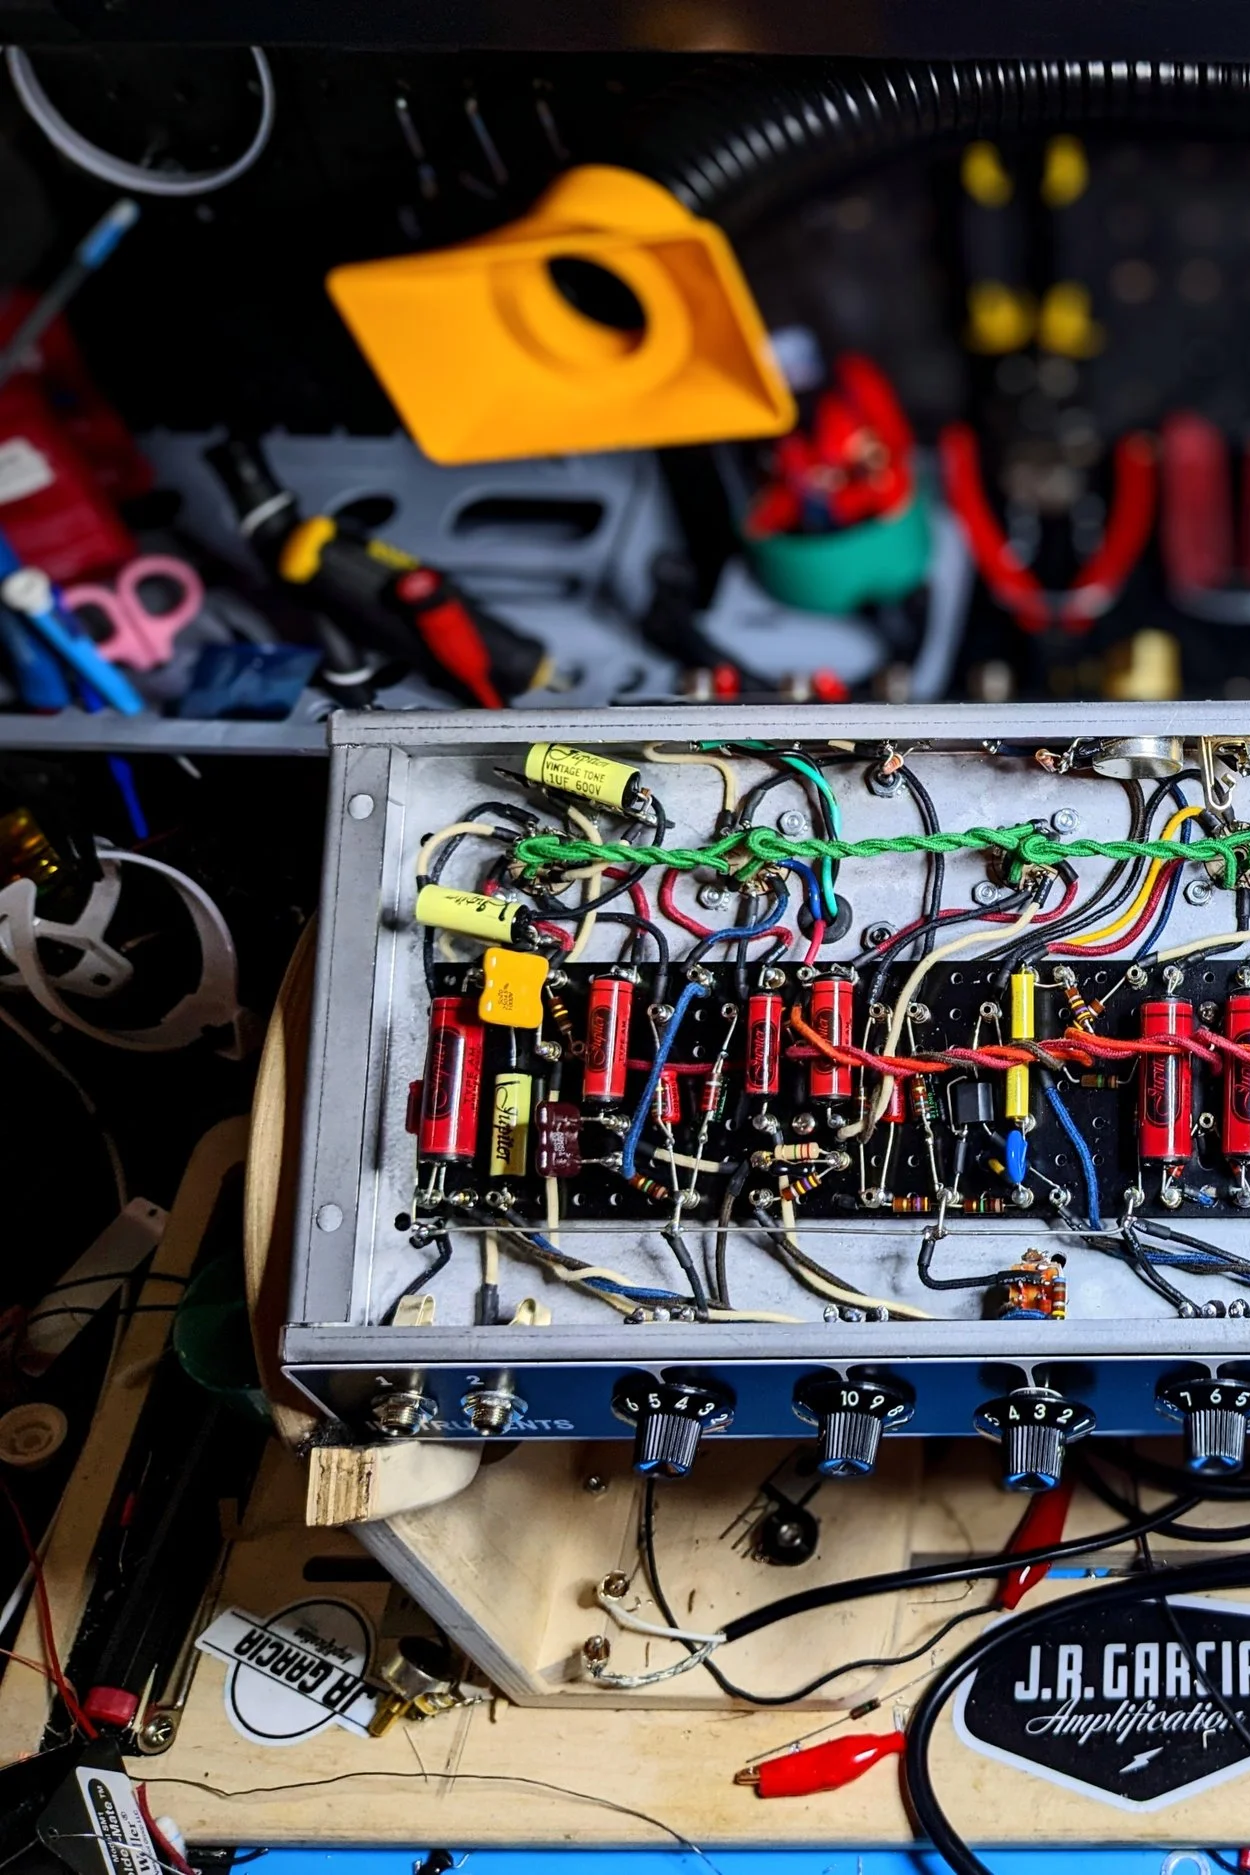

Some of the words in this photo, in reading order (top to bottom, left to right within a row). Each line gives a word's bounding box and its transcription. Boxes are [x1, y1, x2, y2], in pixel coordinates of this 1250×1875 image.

[545, 761, 581, 778] VINTAGE
[583, 769, 606, 784] TONE
[575, 780, 602, 796] 600V
[618, 1034, 626, 1061] TYPE
[495, 1084, 515, 1165] Jupiter
[375, 1376, 393, 1386] 1
[466, 1375, 485, 1386] 2
[626, 1397, 640, 1412] 6
[648, 1393, 661, 1408] 5
[674, 1396, 689, 1410] 4
[698, 1402, 715, 1416] 3
[840, 1390, 860, 1407] 10
[869, 1395, 885, 1410] 9
[887, 1404, 904, 1418] 8
[1180, 1391, 1193, 1407] 7
[1209, 1388, 1222, 1404] 6
[1235, 1391, 1250, 1407] 5
[1008, 1405, 1021, 1421] 4
[1033, 1403, 1047, 1419] 3
[1056, 1408, 1073, 1424] 2
[365, 1418, 576, 1431] ITRUENTS
[233, 1628, 334, 1695] GARCIA
[97, 1812, 110, 1833] SM1
